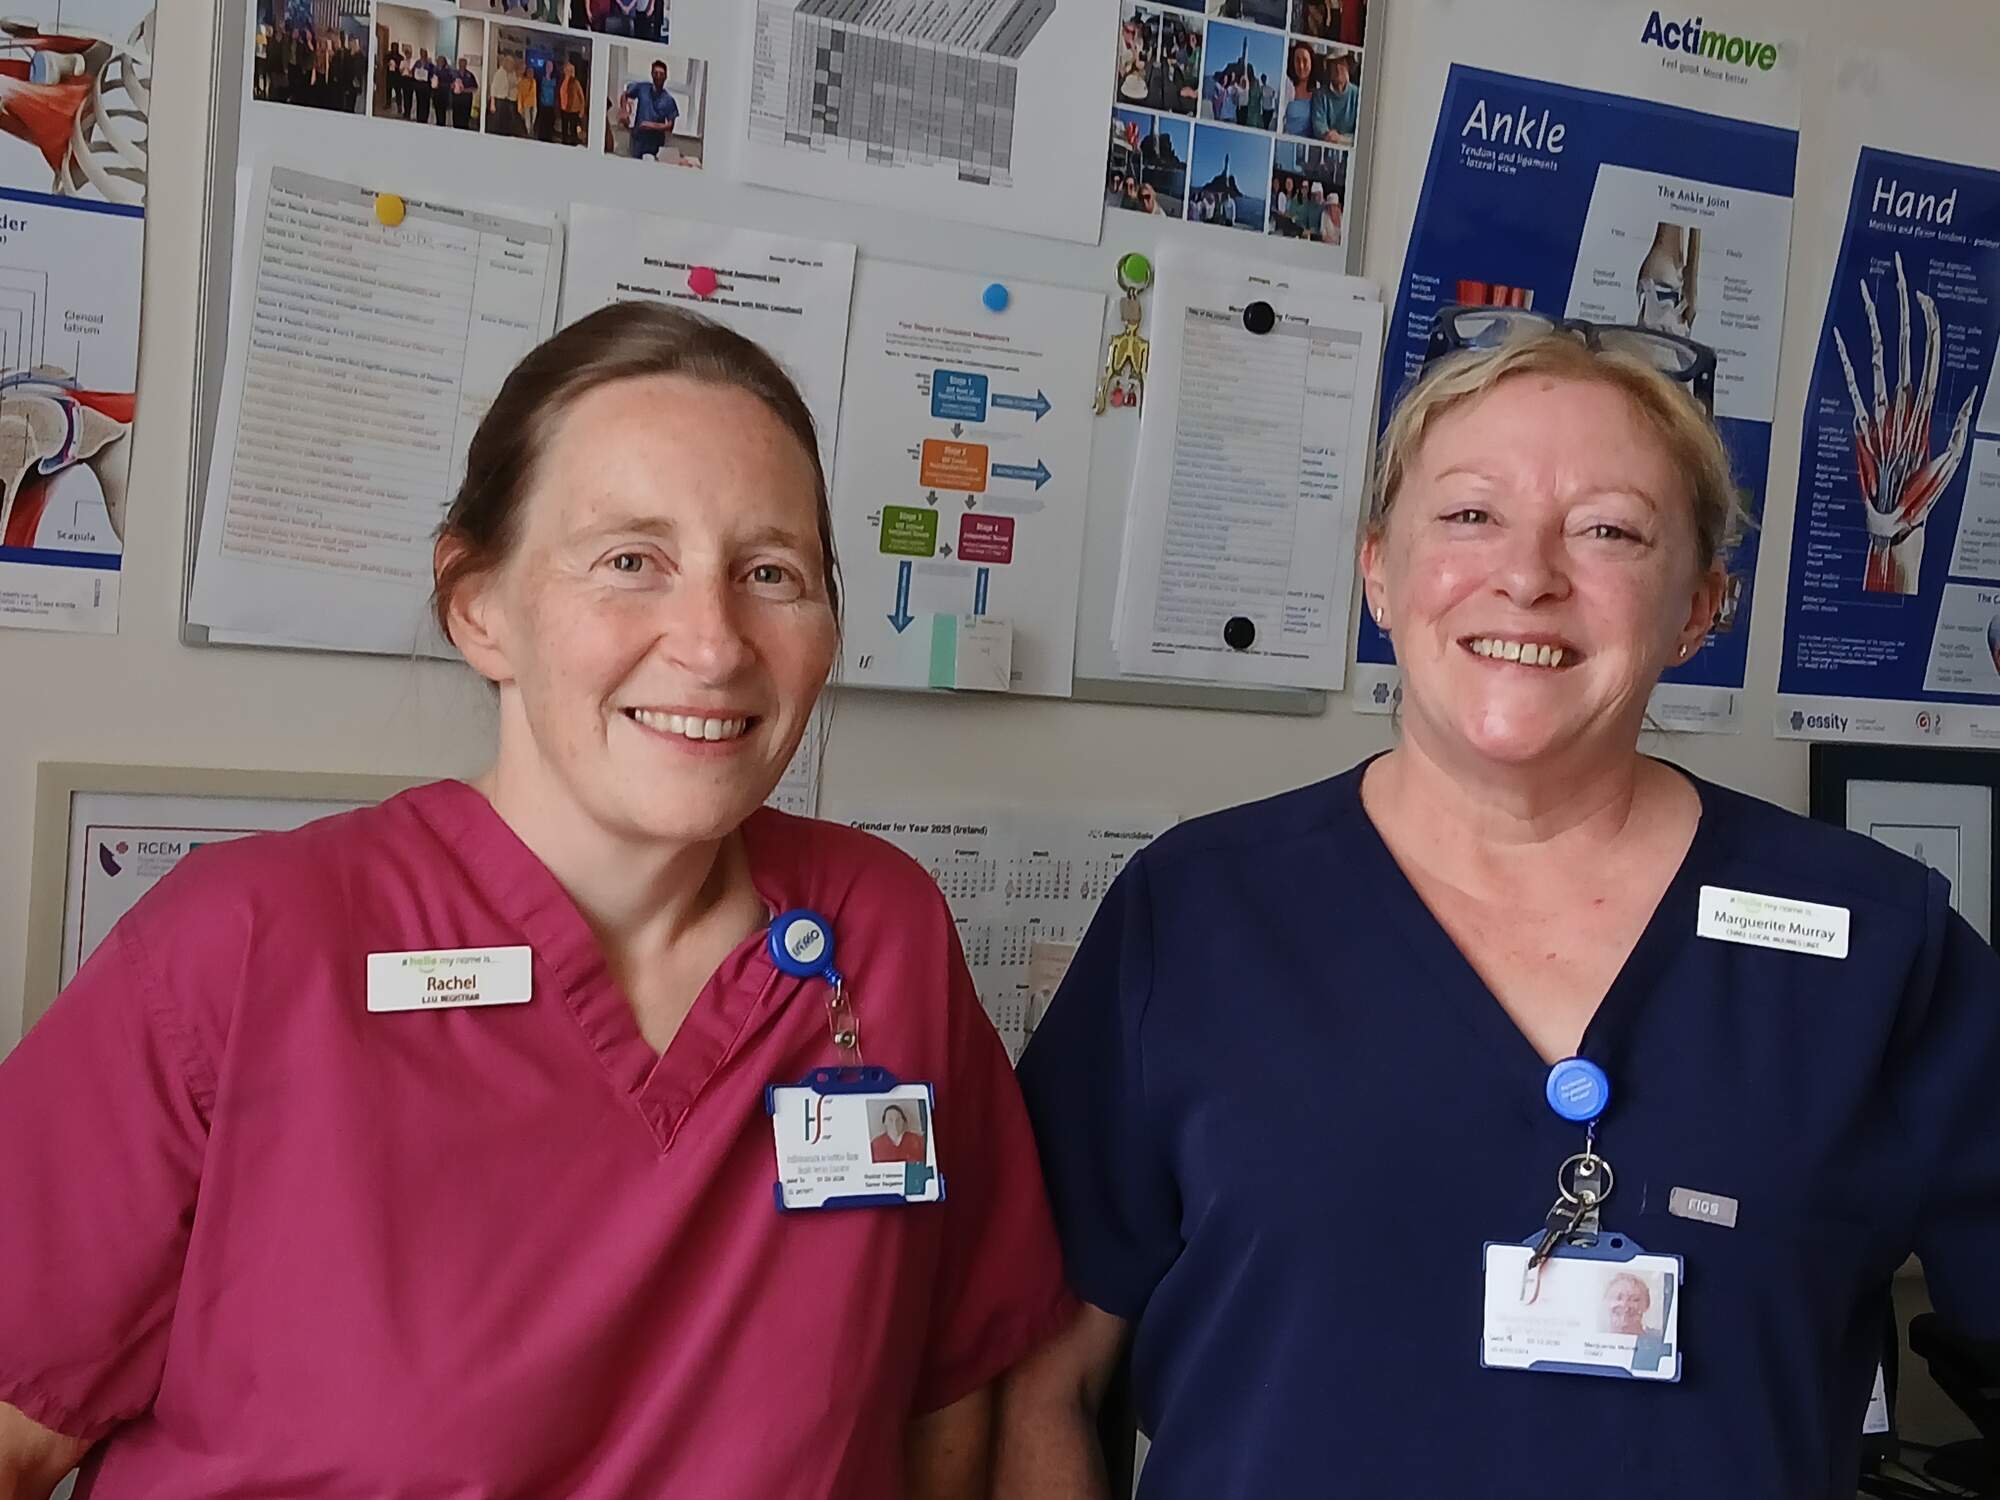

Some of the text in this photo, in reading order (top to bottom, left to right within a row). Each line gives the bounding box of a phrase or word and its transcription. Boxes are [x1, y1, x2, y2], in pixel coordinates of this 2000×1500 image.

[1641, 11, 1777, 71] Actimove
[1461, 100, 1565, 153] Ankle
[1461, 143, 1558, 171] Tendons and ligaments
[1466, 157, 1496, 171] lateral
[1658, 185, 1730, 209] The Ankle Joint
[1872, 177, 1957, 225] Hand
[57, 530, 96, 542] Scapula
[1807, 713, 1848, 733] essity
[850, 821, 988, 836] Calendar for Year 2025 (Ireland)
[138, 841, 181, 855] RCEM
[1714, 910, 1836, 943] Marguerite Murray
[439, 957, 453, 967] my
[456, 956, 481, 964] name
[427, 974, 476, 991] Rachel
[440, 993, 480, 1003] REGISTRAR
